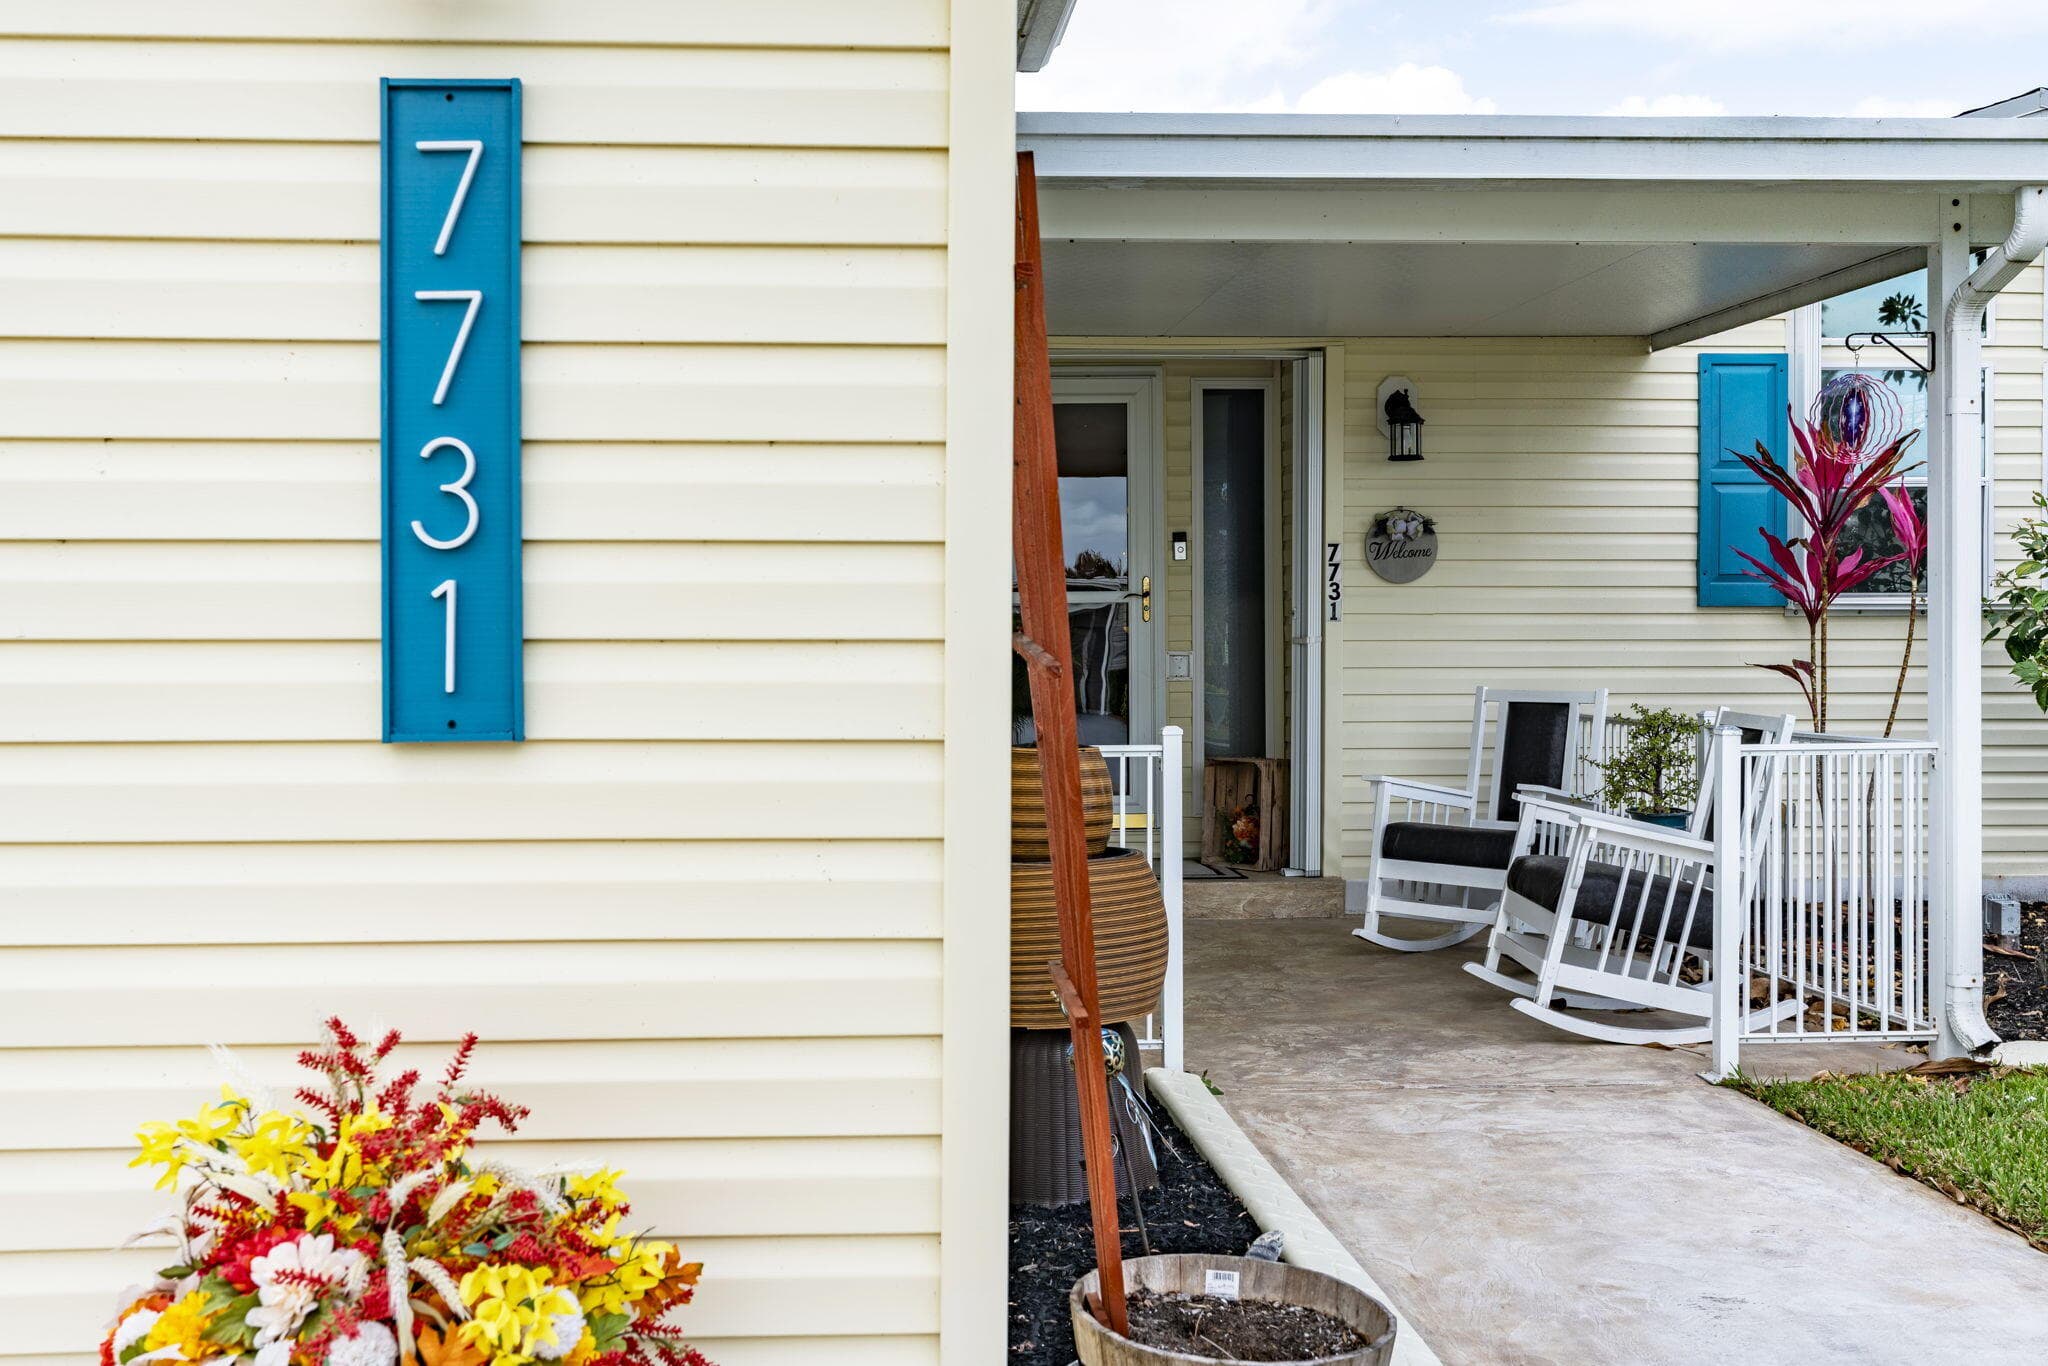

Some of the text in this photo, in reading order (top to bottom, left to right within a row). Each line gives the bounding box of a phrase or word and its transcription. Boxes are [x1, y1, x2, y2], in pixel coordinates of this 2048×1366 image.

[411, 140, 483, 693] 7731
[1327, 543, 1341, 621] 7731
[1369, 541, 1432, 561] Welcome
